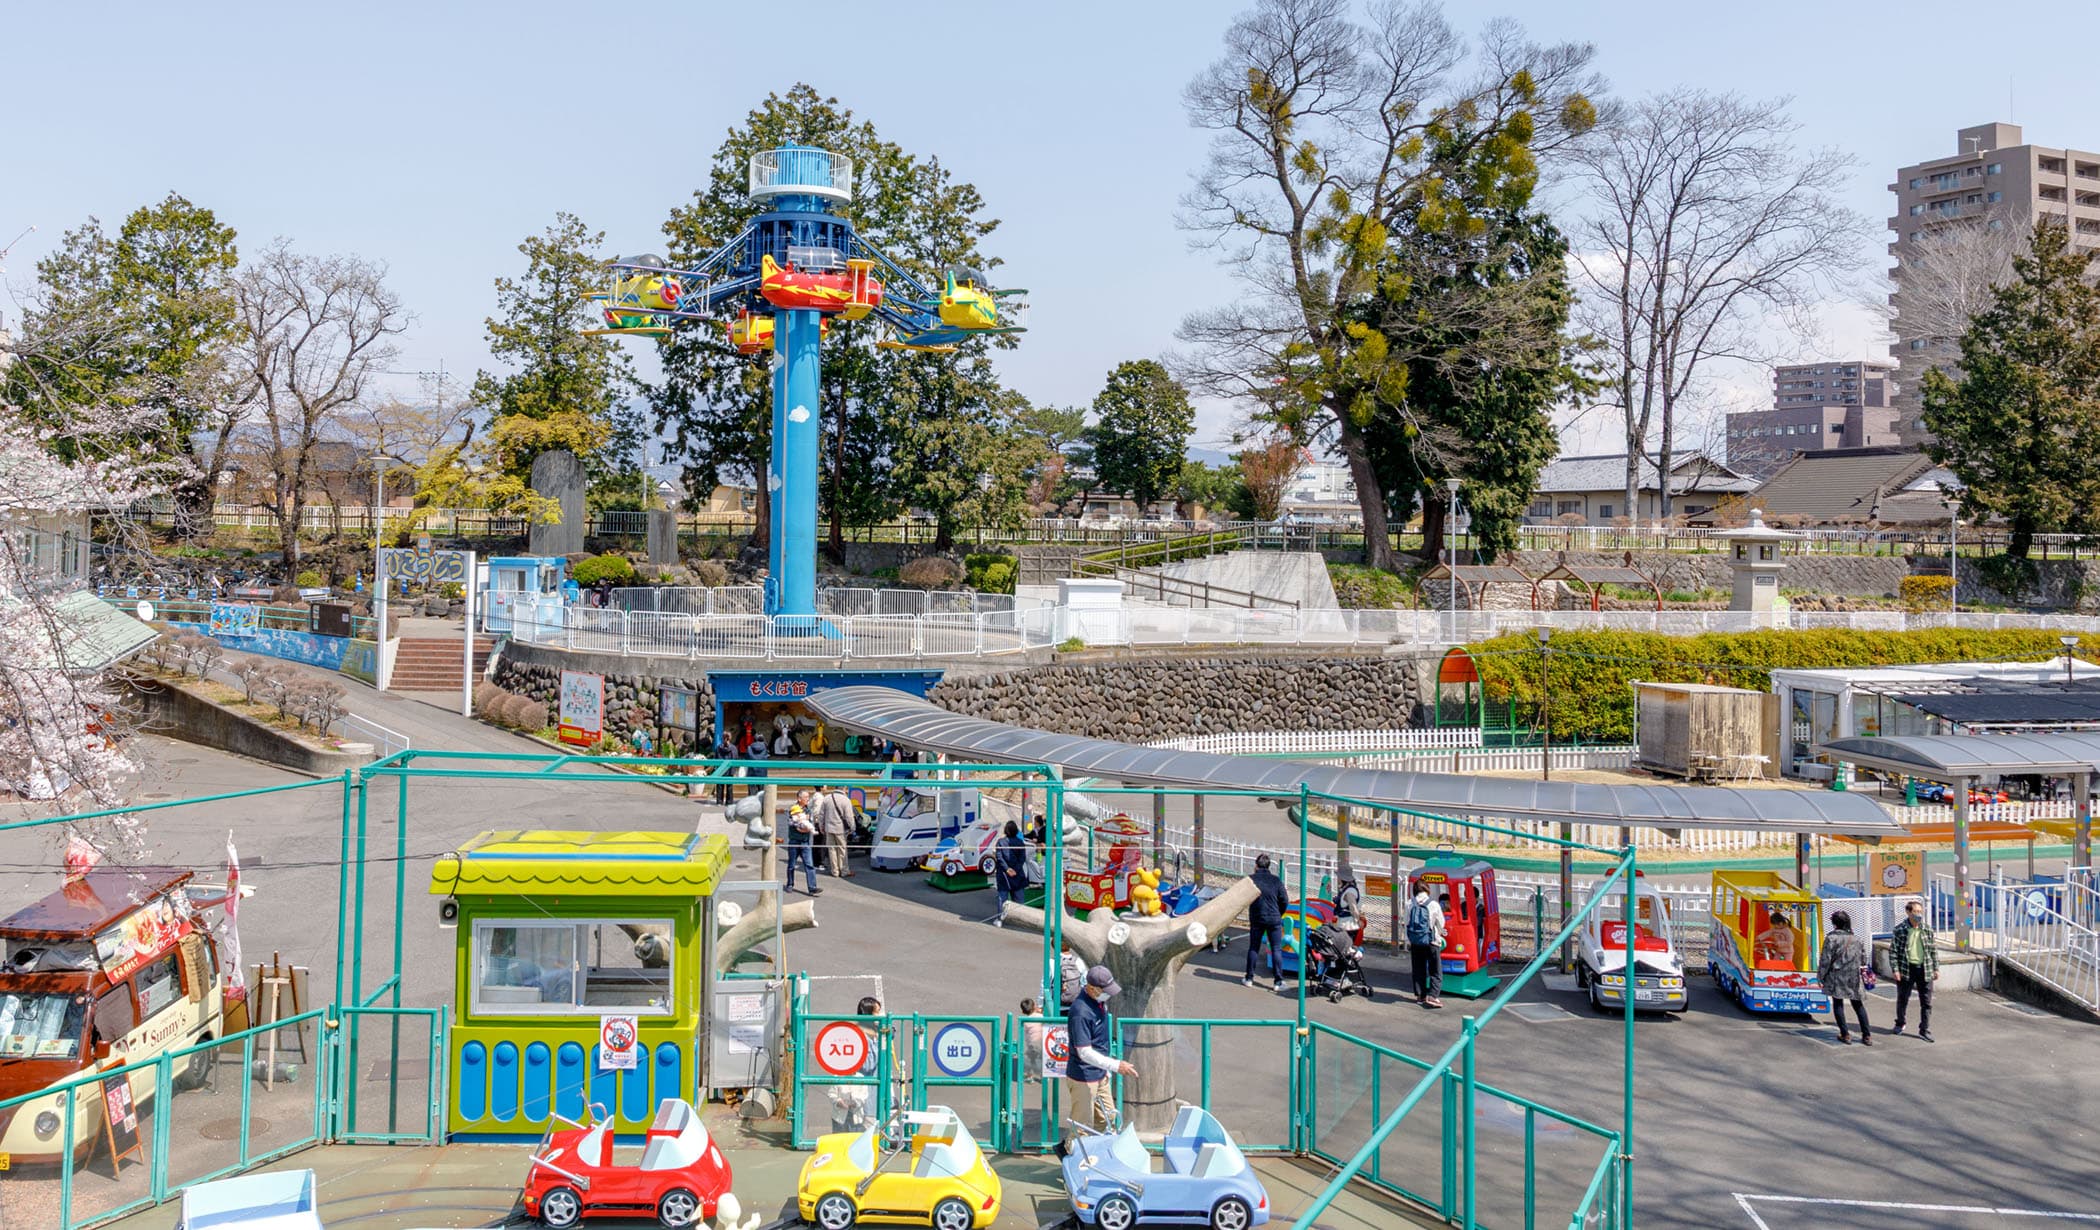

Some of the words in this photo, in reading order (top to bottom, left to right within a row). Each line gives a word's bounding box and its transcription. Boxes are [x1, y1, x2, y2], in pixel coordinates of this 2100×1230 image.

[749, 681, 808, 696] もくば館
[150, 1011, 187, 1047] Sunny's
[829, 1043, 854, 1057] 入口
[947, 1045, 972, 1057] 出口
